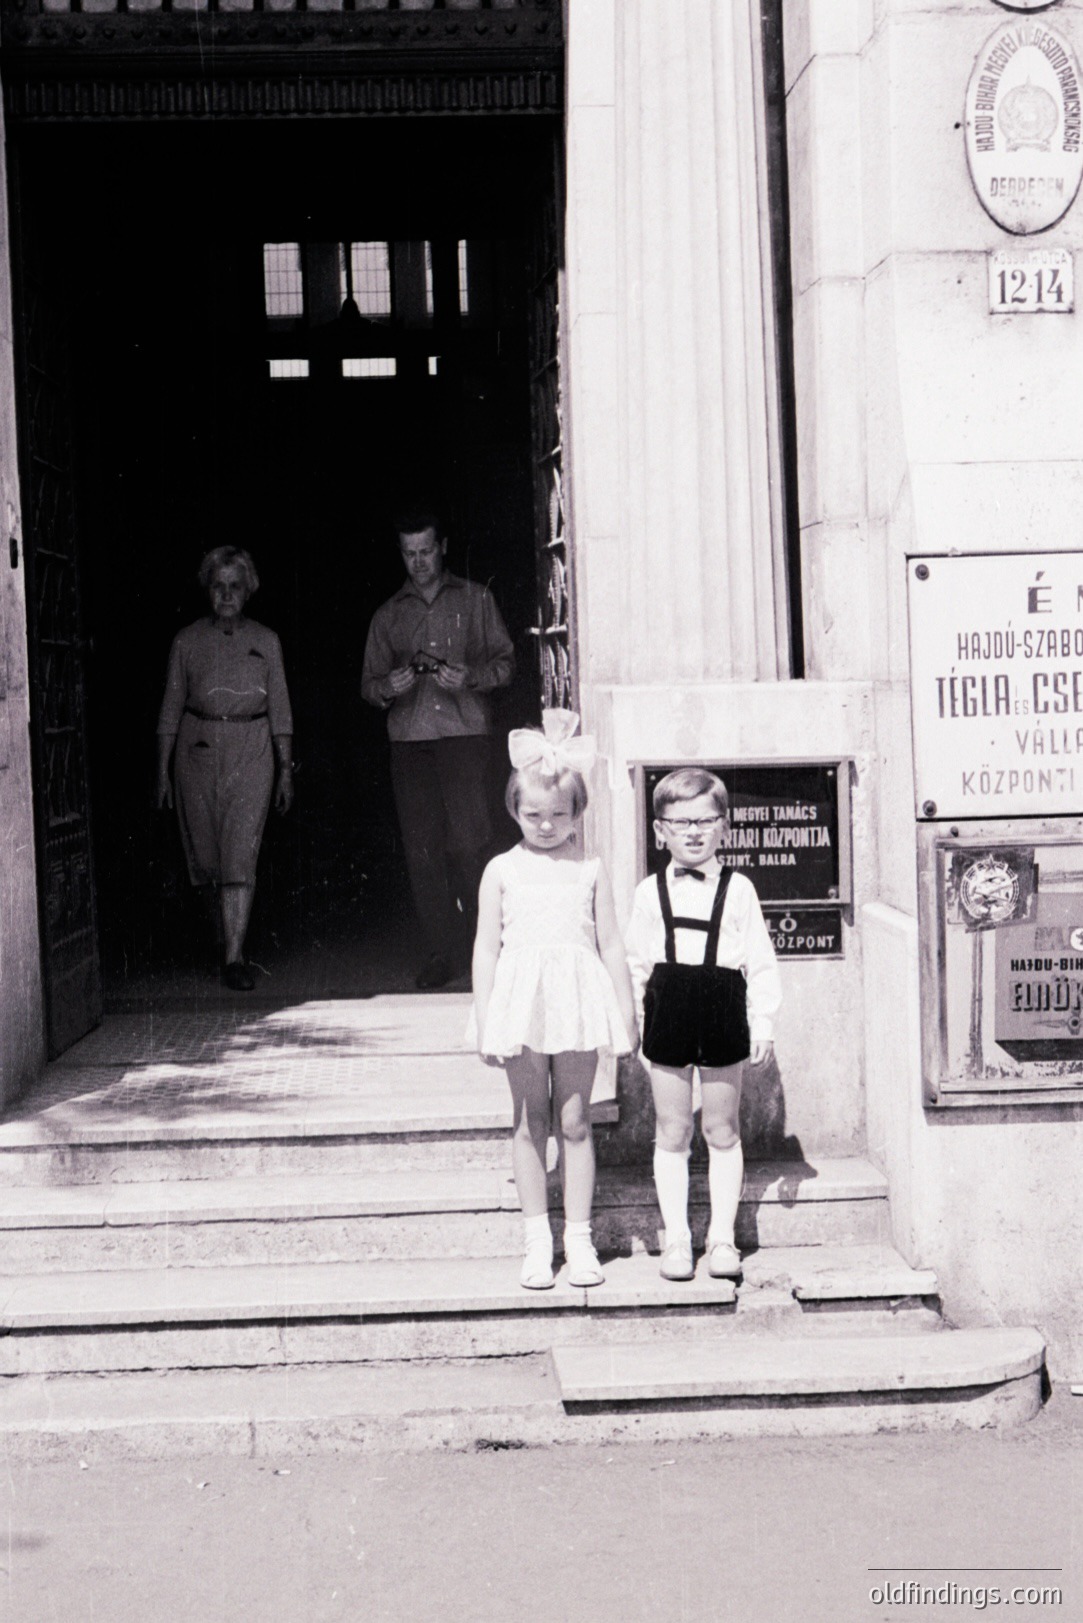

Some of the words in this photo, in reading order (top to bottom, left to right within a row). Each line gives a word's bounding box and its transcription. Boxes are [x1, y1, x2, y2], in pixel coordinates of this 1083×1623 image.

[935, 667, 1010, 719] TÉGLA
[962, 764, 1075, 796] KÖZPONTI
[733, 806, 769, 822] MEGYEI
[772, 800, 817, 821] TANÁCS
[763, 822, 831, 849] KÖZPONTJA
[759, 853, 797, 866] BALRA
